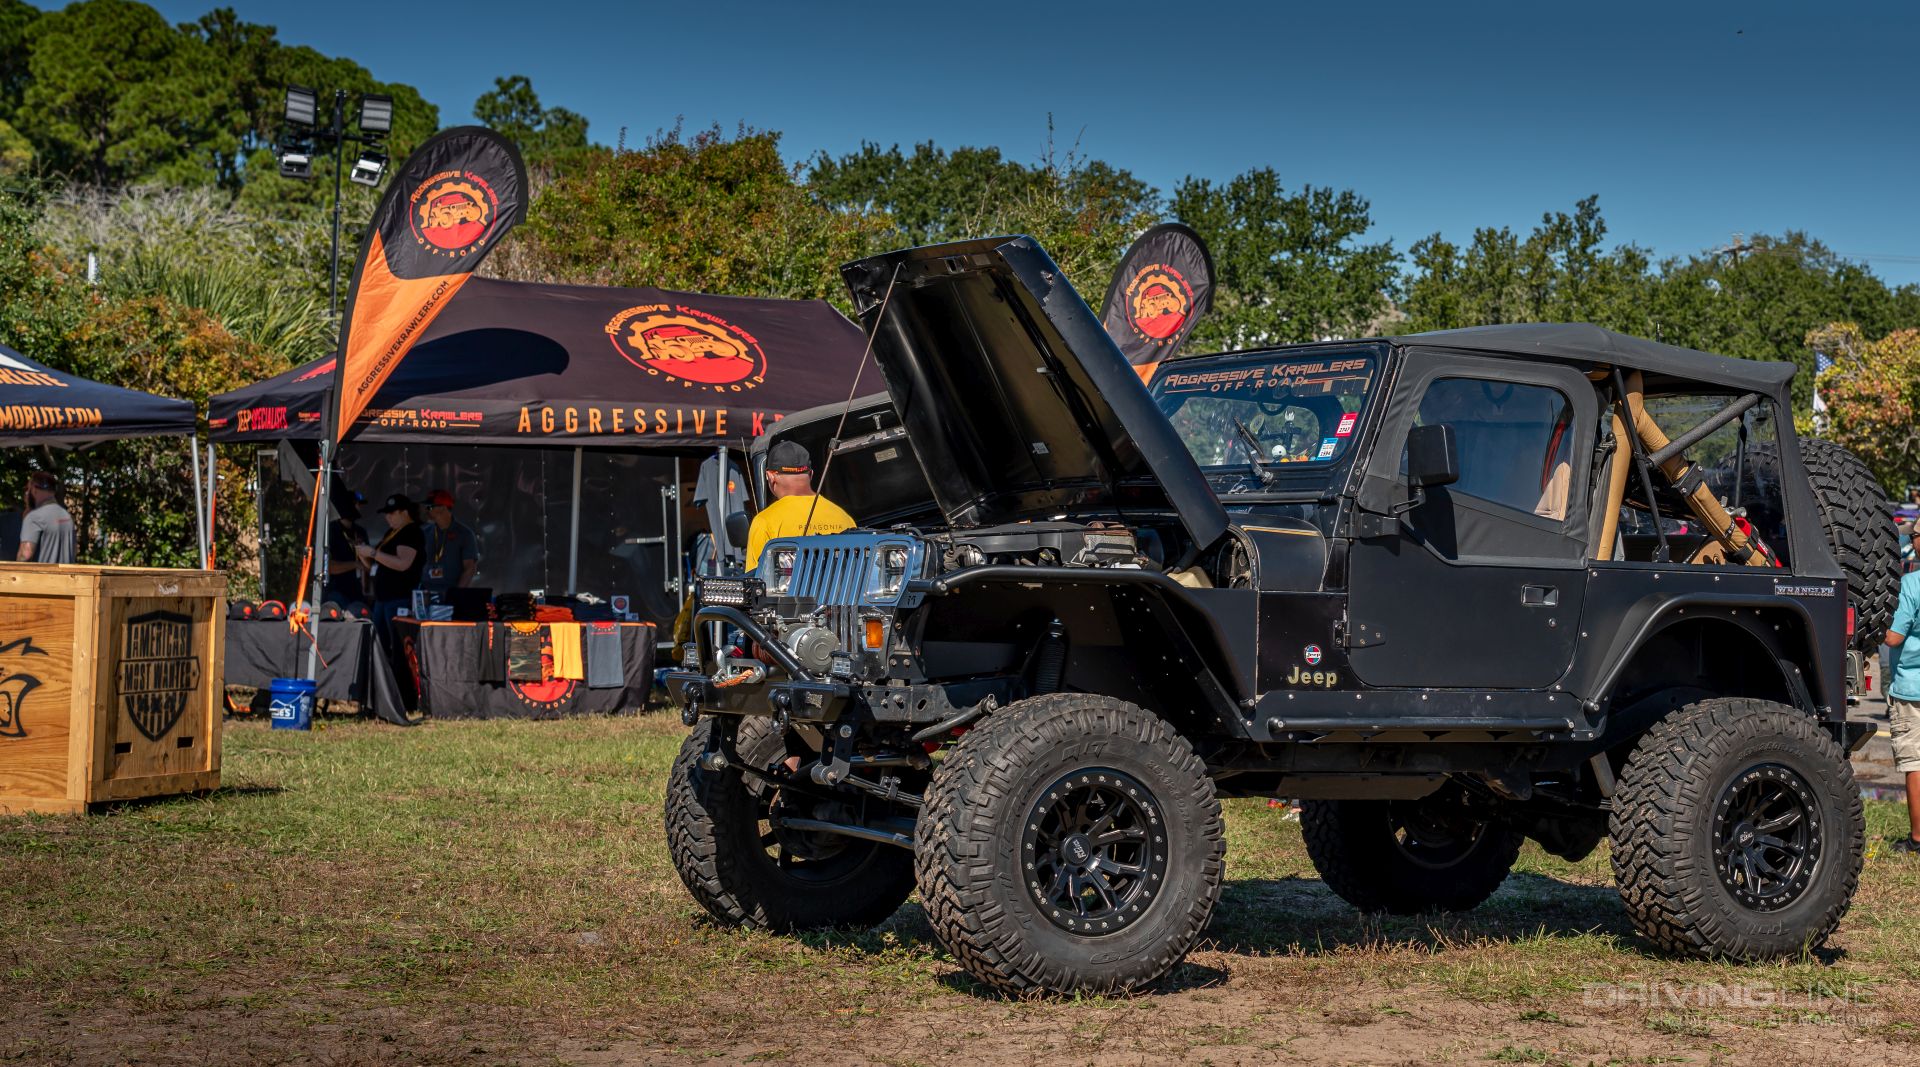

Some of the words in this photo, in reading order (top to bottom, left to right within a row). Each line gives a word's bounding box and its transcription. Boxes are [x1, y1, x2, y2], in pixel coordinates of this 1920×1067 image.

[357, 280, 450, 396] AGGRESSIVEKRAWLERS.COM
[1164, 368, 1266, 388] AGGRESSIVE
[1271, 358, 1367, 378] KRAWLERS
[1210, 376, 1304, 392] OFF-ROAD
[381, 419, 447, 428] OFF-ROAD
[518, 407, 728, 435] AGGRESSIVE
[1776, 586, 1835, 595] WRANGLER
[1287, 666, 1338, 688] Jeep
